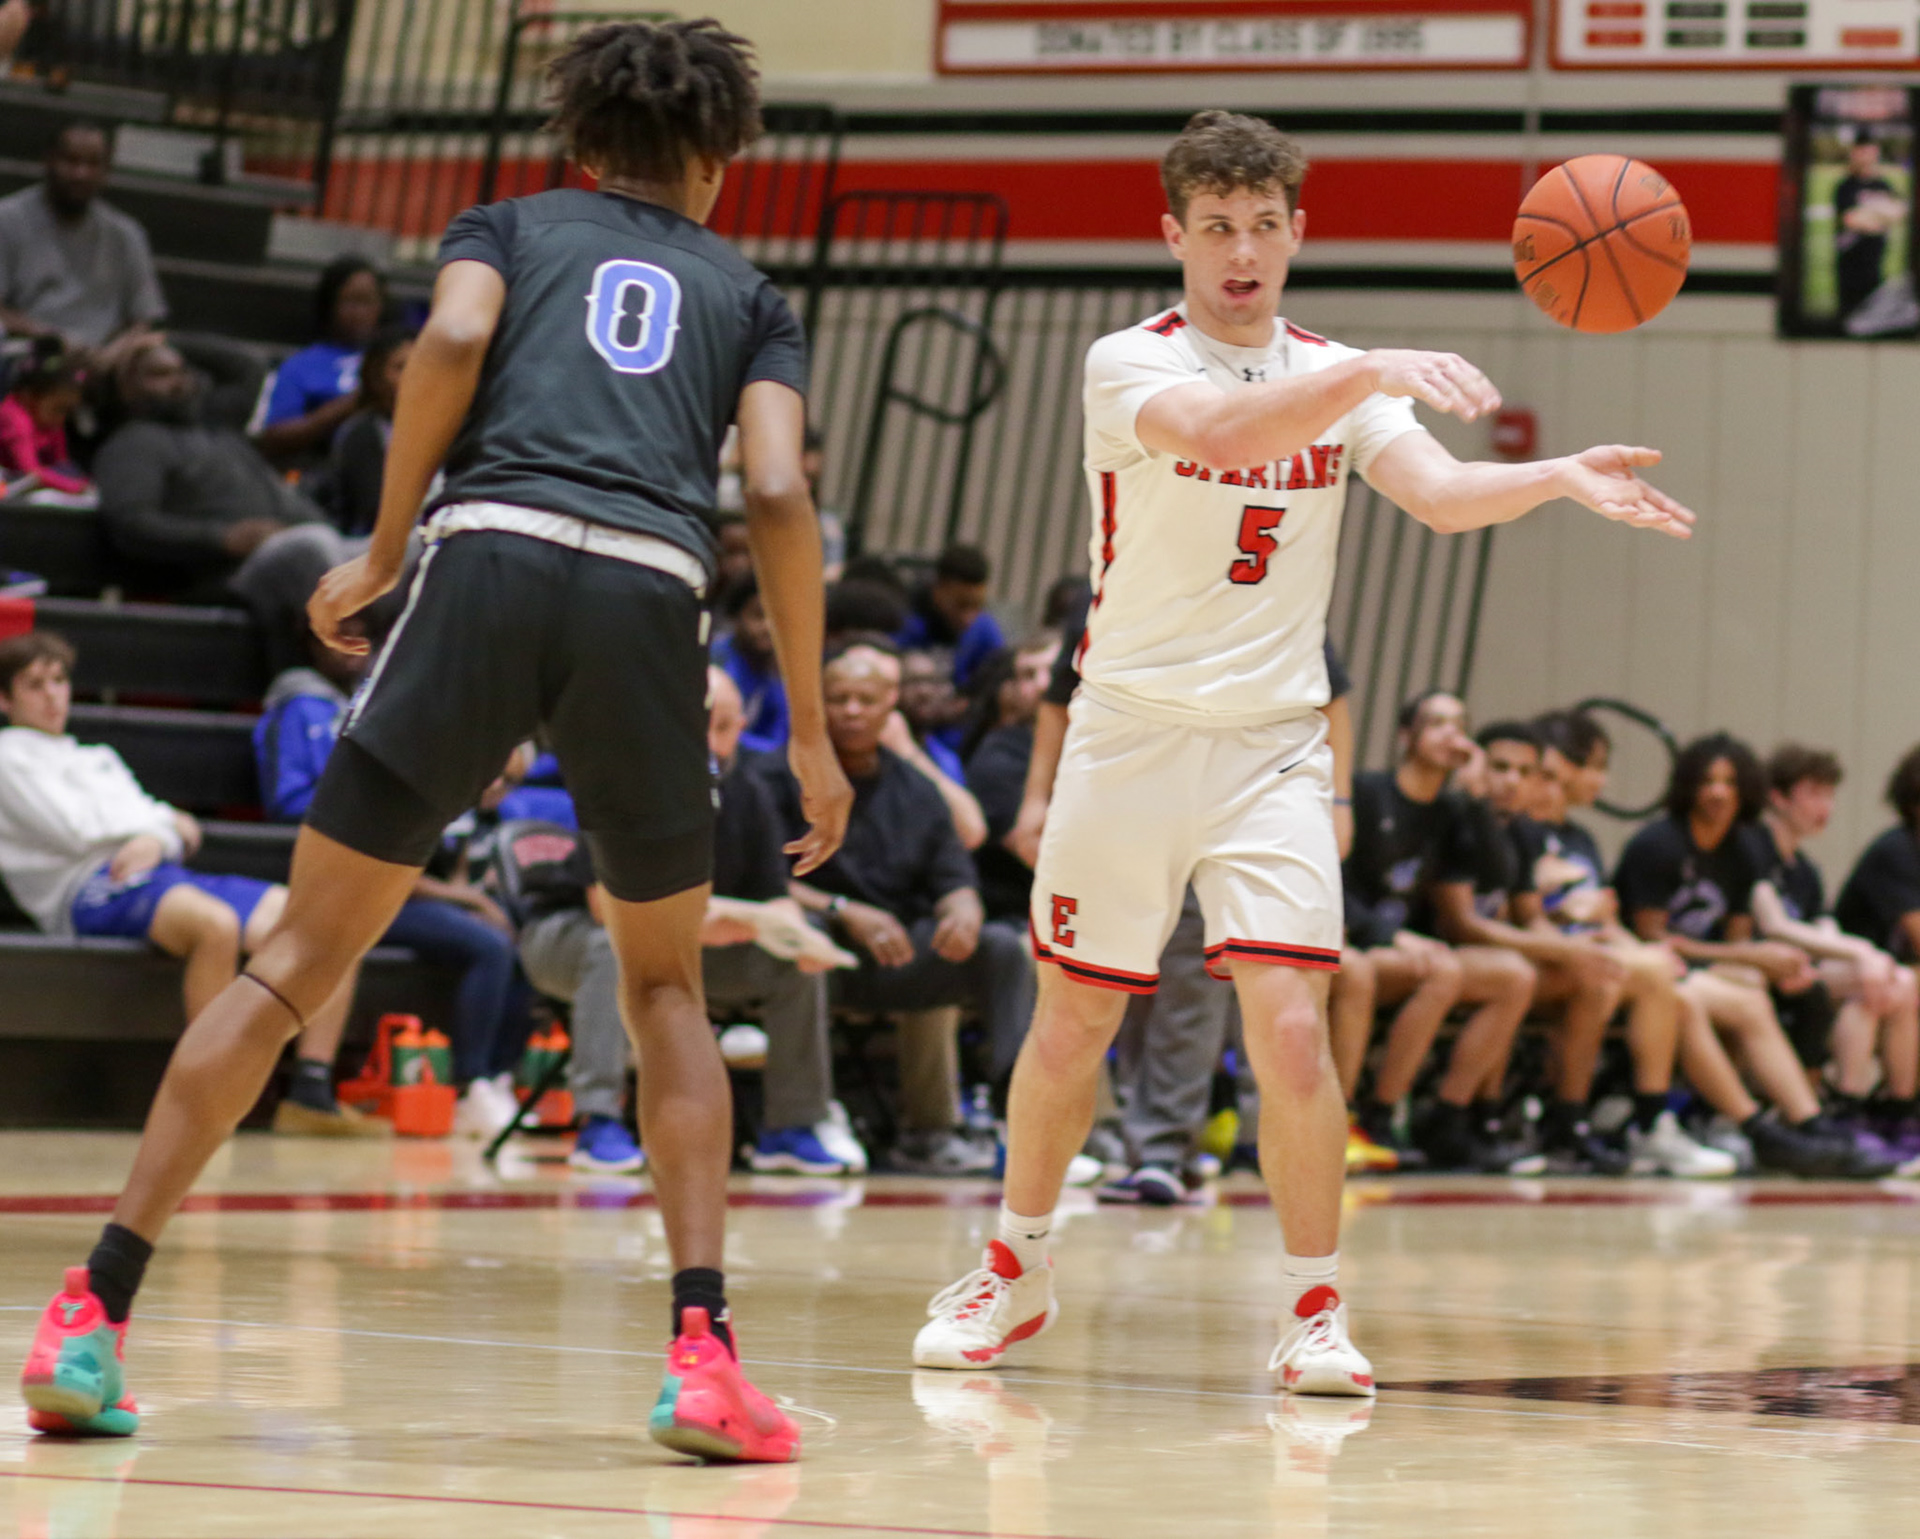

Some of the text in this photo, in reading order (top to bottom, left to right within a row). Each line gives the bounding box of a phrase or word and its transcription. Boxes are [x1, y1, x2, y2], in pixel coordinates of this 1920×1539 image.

[584, 259, 682, 374] 0
[1228, 505, 1286, 585] 5
[1051, 893, 1078, 948] E
